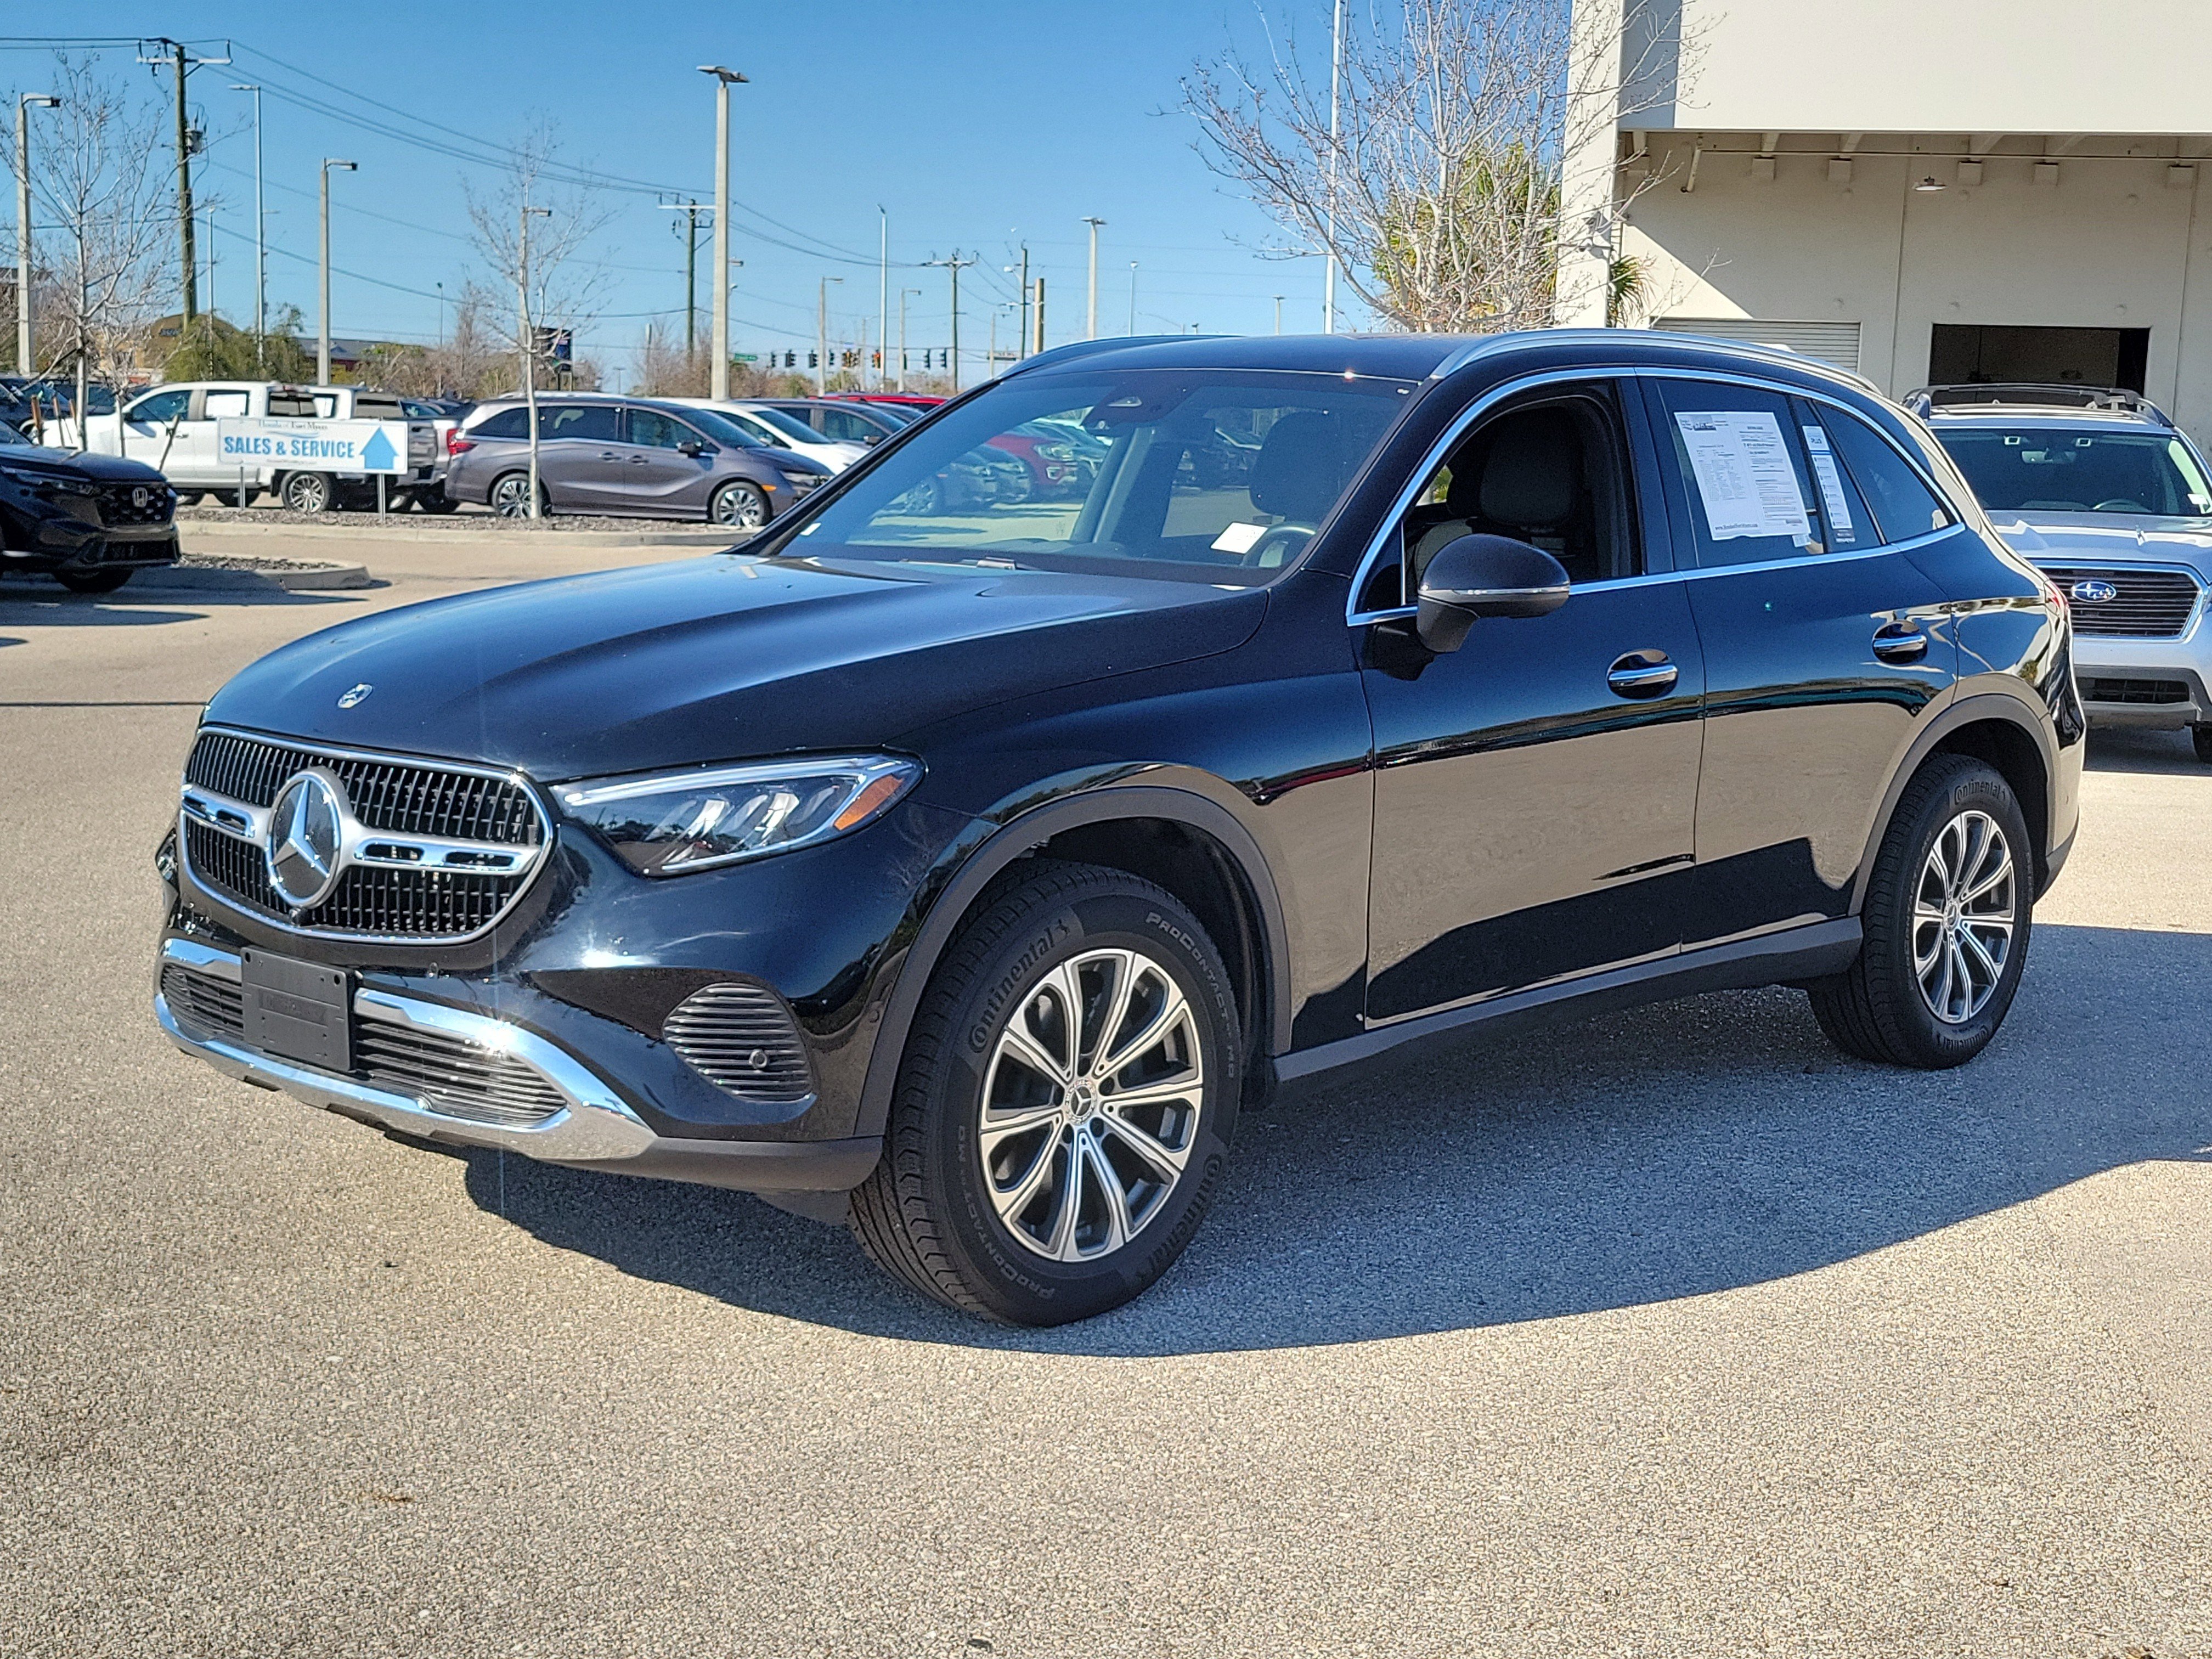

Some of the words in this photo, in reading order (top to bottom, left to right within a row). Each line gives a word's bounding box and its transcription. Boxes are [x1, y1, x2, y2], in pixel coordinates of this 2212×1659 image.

[224, 437, 272, 455] SALES
[276, 441, 286, 455] &
[291, 439, 355, 458] SERVICE
[1954, 779, 2001, 805] Continental
[968, 926, 1056, 1054] Continental
